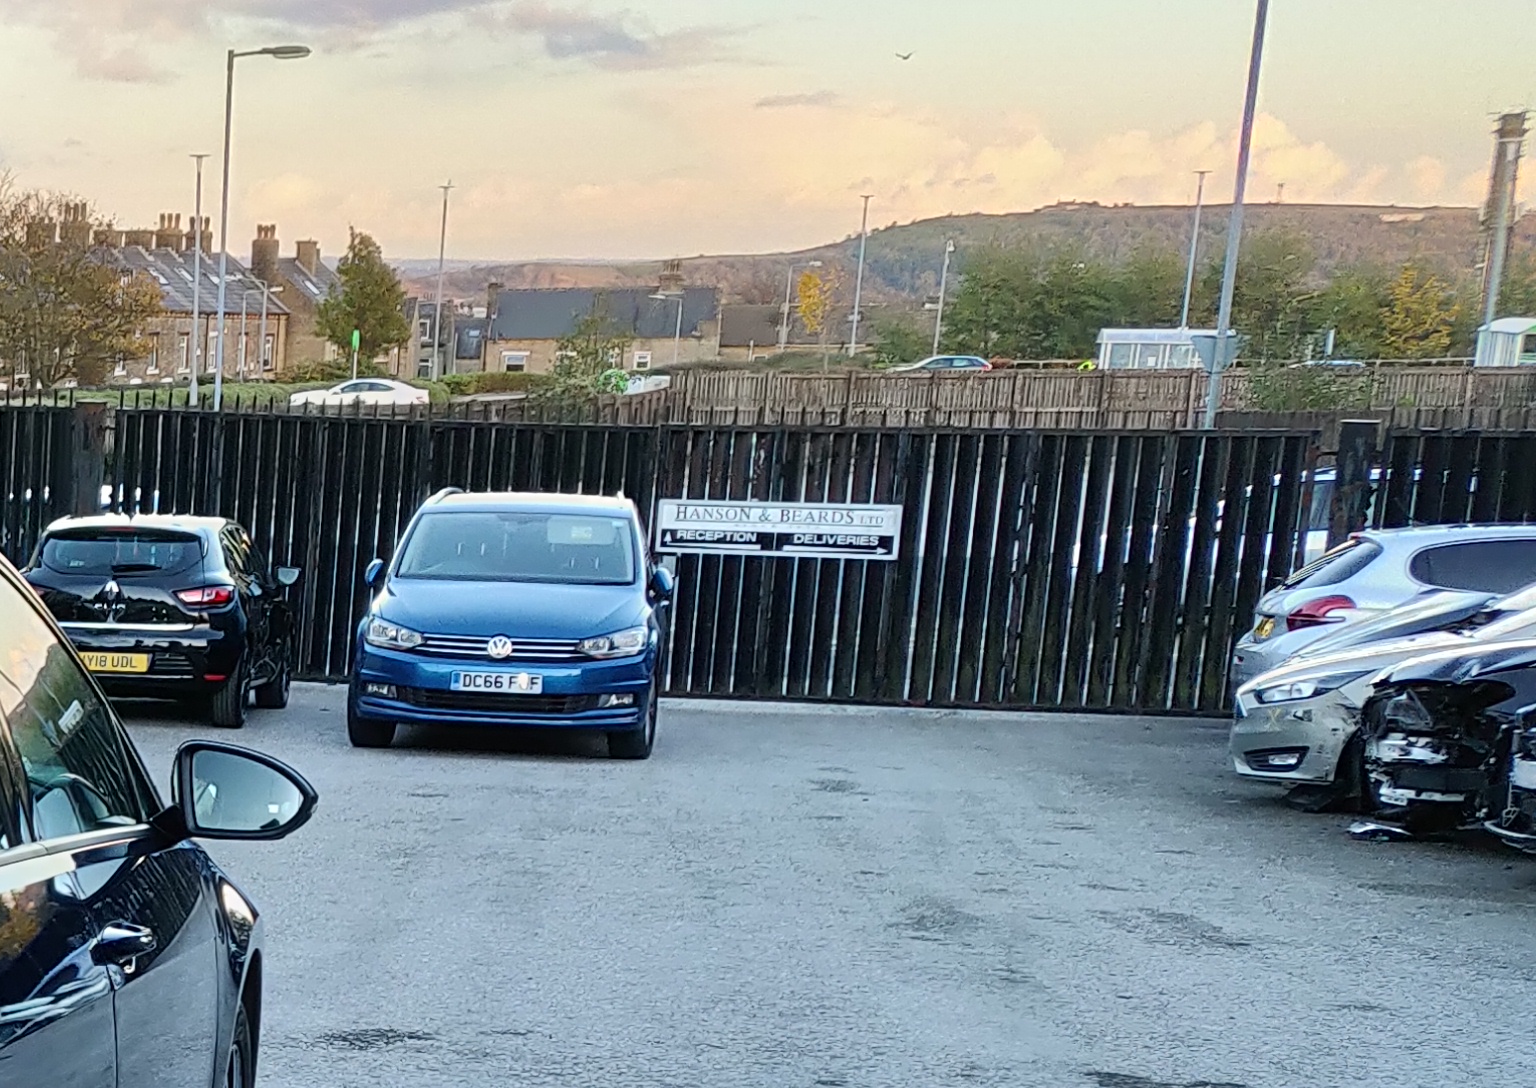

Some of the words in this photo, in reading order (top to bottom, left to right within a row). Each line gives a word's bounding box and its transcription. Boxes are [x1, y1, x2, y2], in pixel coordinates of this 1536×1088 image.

[675, 506, 751, 521] HANSON
[758, 508, 772, 522] &
[780, 508, 855, 525] BEARDS
[860, 514, 884, 526] LTD
[676, 530, 757, 543] RECEPTION
[793, 533, 880, 546] DELIVERIES
[111, 656, 138, 669] UDL
[462, 673, 504, 689] DC66
[508, 675, 540, 691] FF
